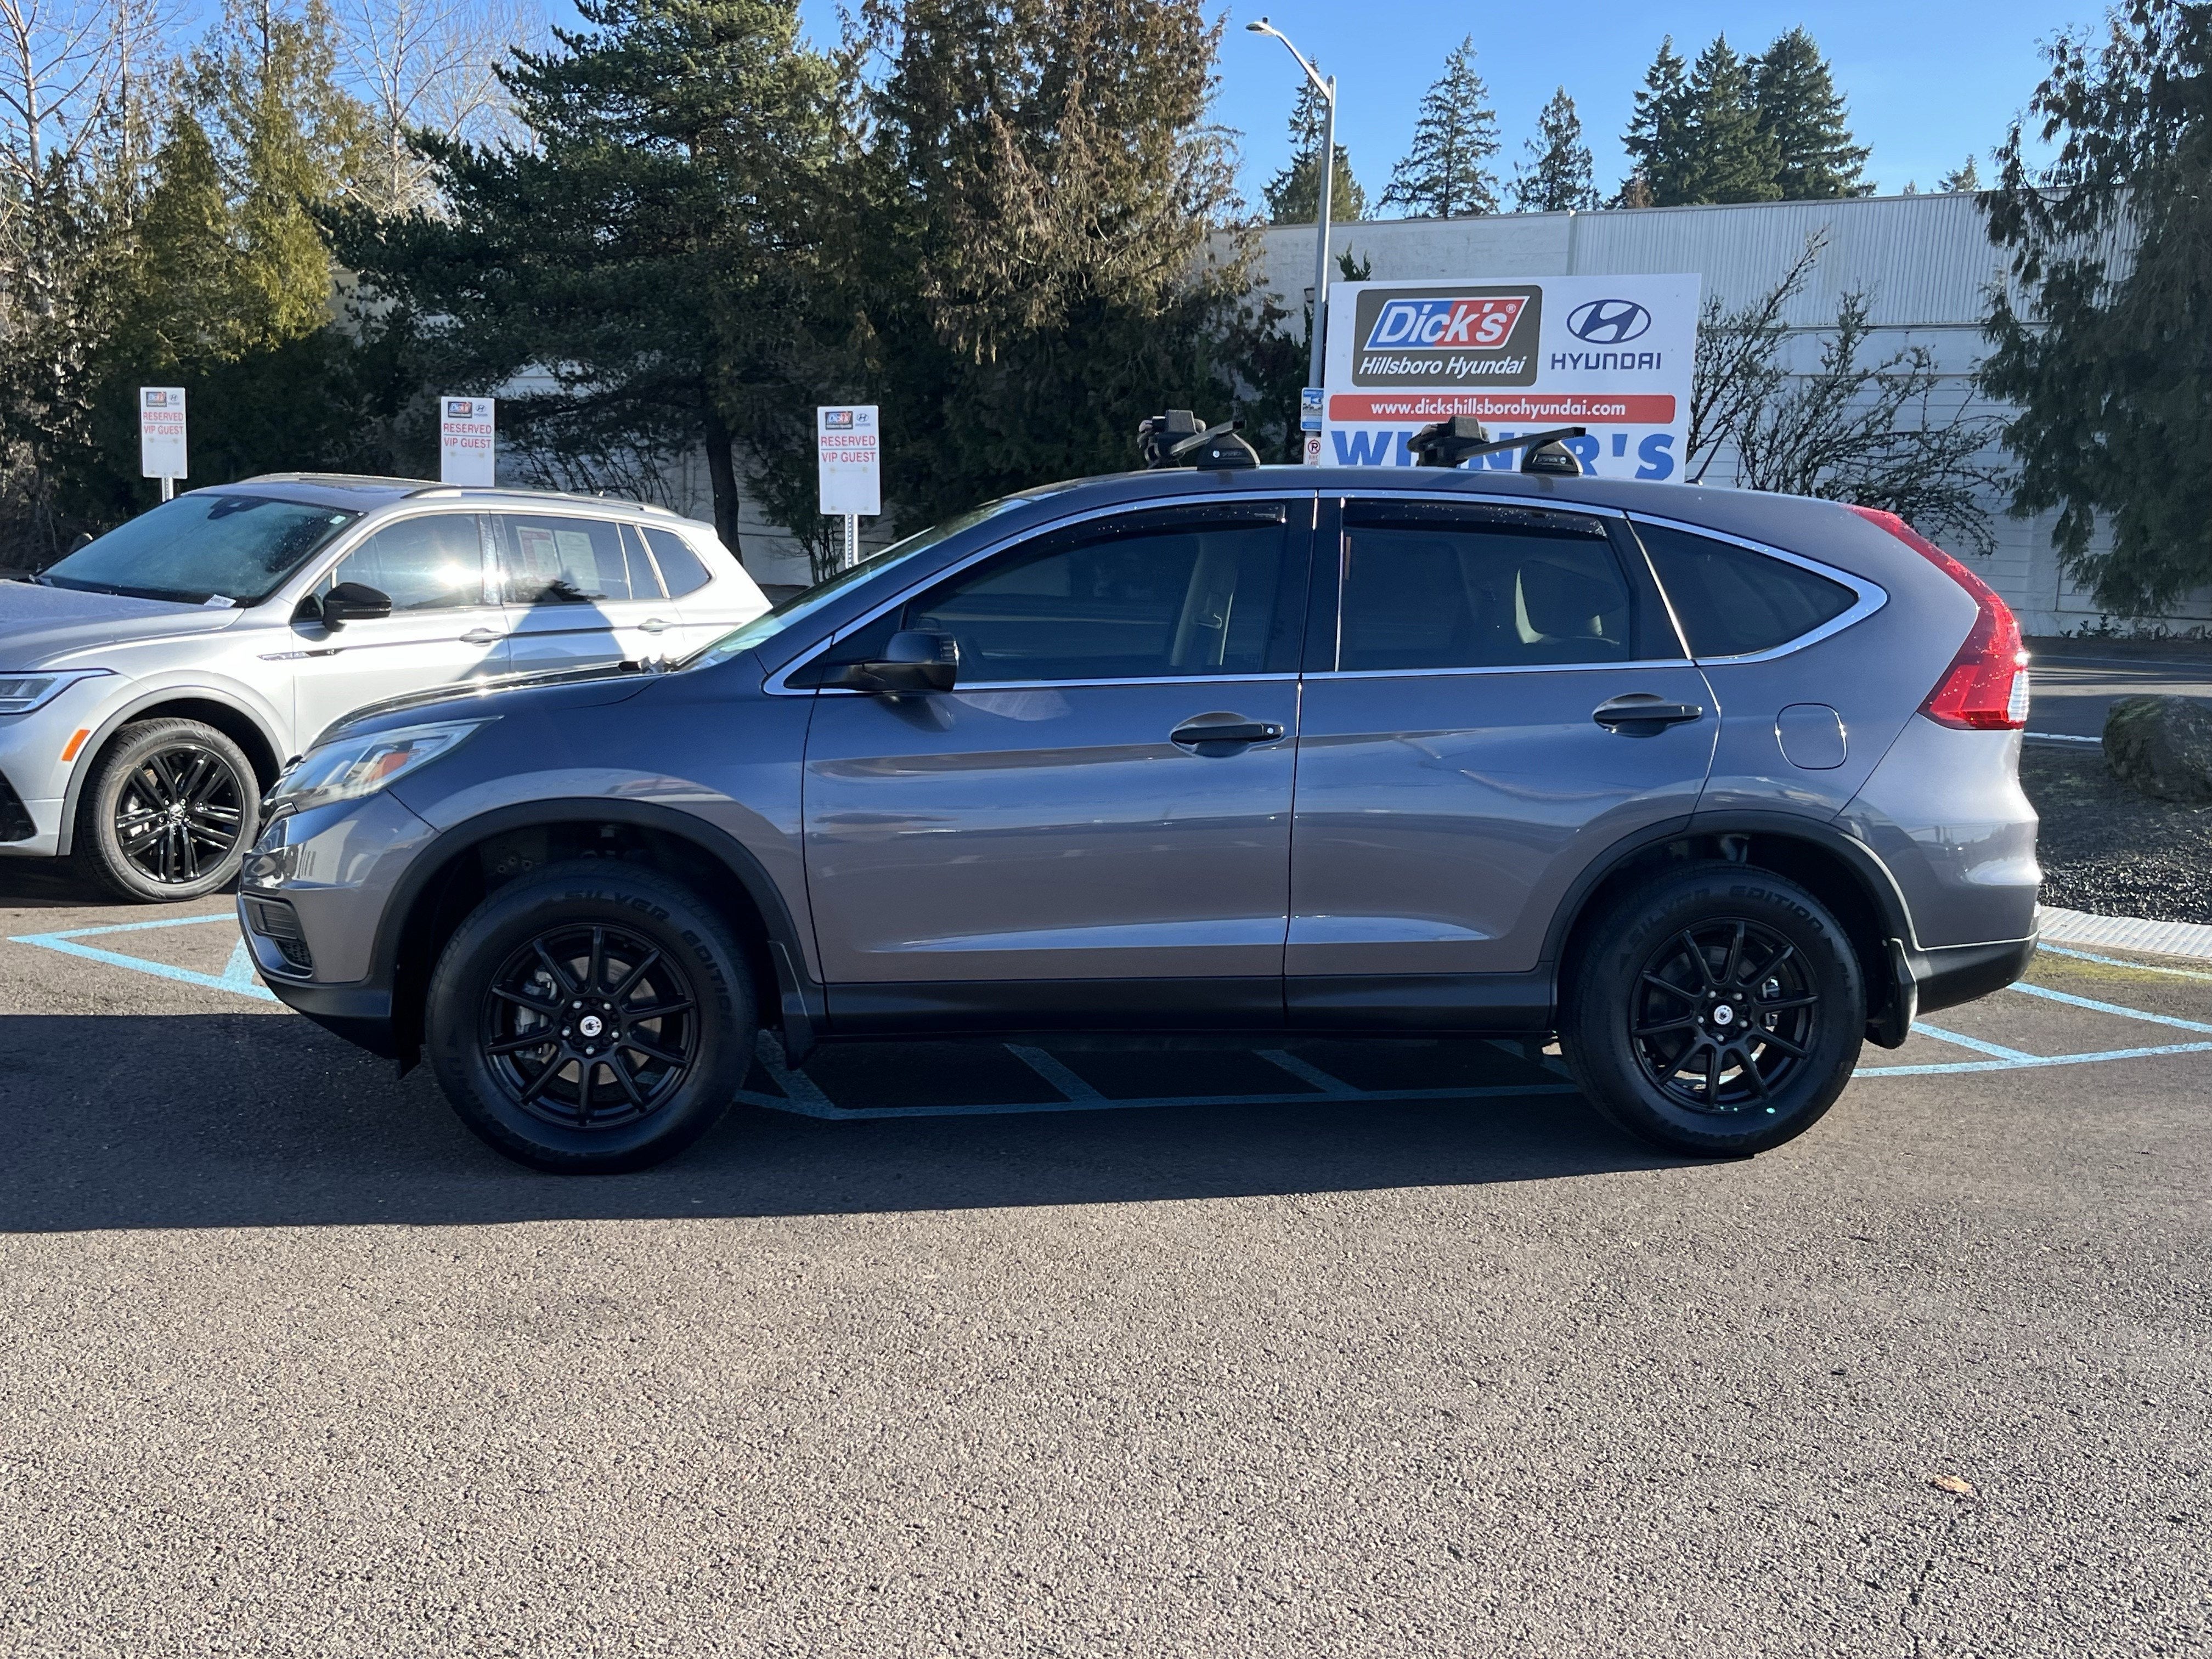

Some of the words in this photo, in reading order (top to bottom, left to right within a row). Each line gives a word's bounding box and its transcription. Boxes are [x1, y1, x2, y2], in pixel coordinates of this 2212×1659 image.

[1376, 302, 1508, 343] Dick's
[1358, 357, 1443, 375] Hillsboro
[1445, 356, 1528, 379] Hyundai
[1550, 352, 1662, 370] HYUNDAI
[143, 412, 184, 421] RESERVED
[1371, 398, 1626, 419] www.dickshillsborohyundai.com
[144, 425, 156, 435] VIP
[157, 426, 184, 435] GUEST
[443, 423, 492, 435] RESERVED
[444, 437, 458, 447] VIP
[461, 438, 492, 449] GUEST
[821, 436, 876, 447] RESERVED
[822, 452, 838, 462] VIP
[840, 452, 876, 462] GUEST
[1331, 431, 1675, 481] WINR'S
[564, 889, 670, 922] SILVER
[1729, 885, 1825, 934] EDITION
